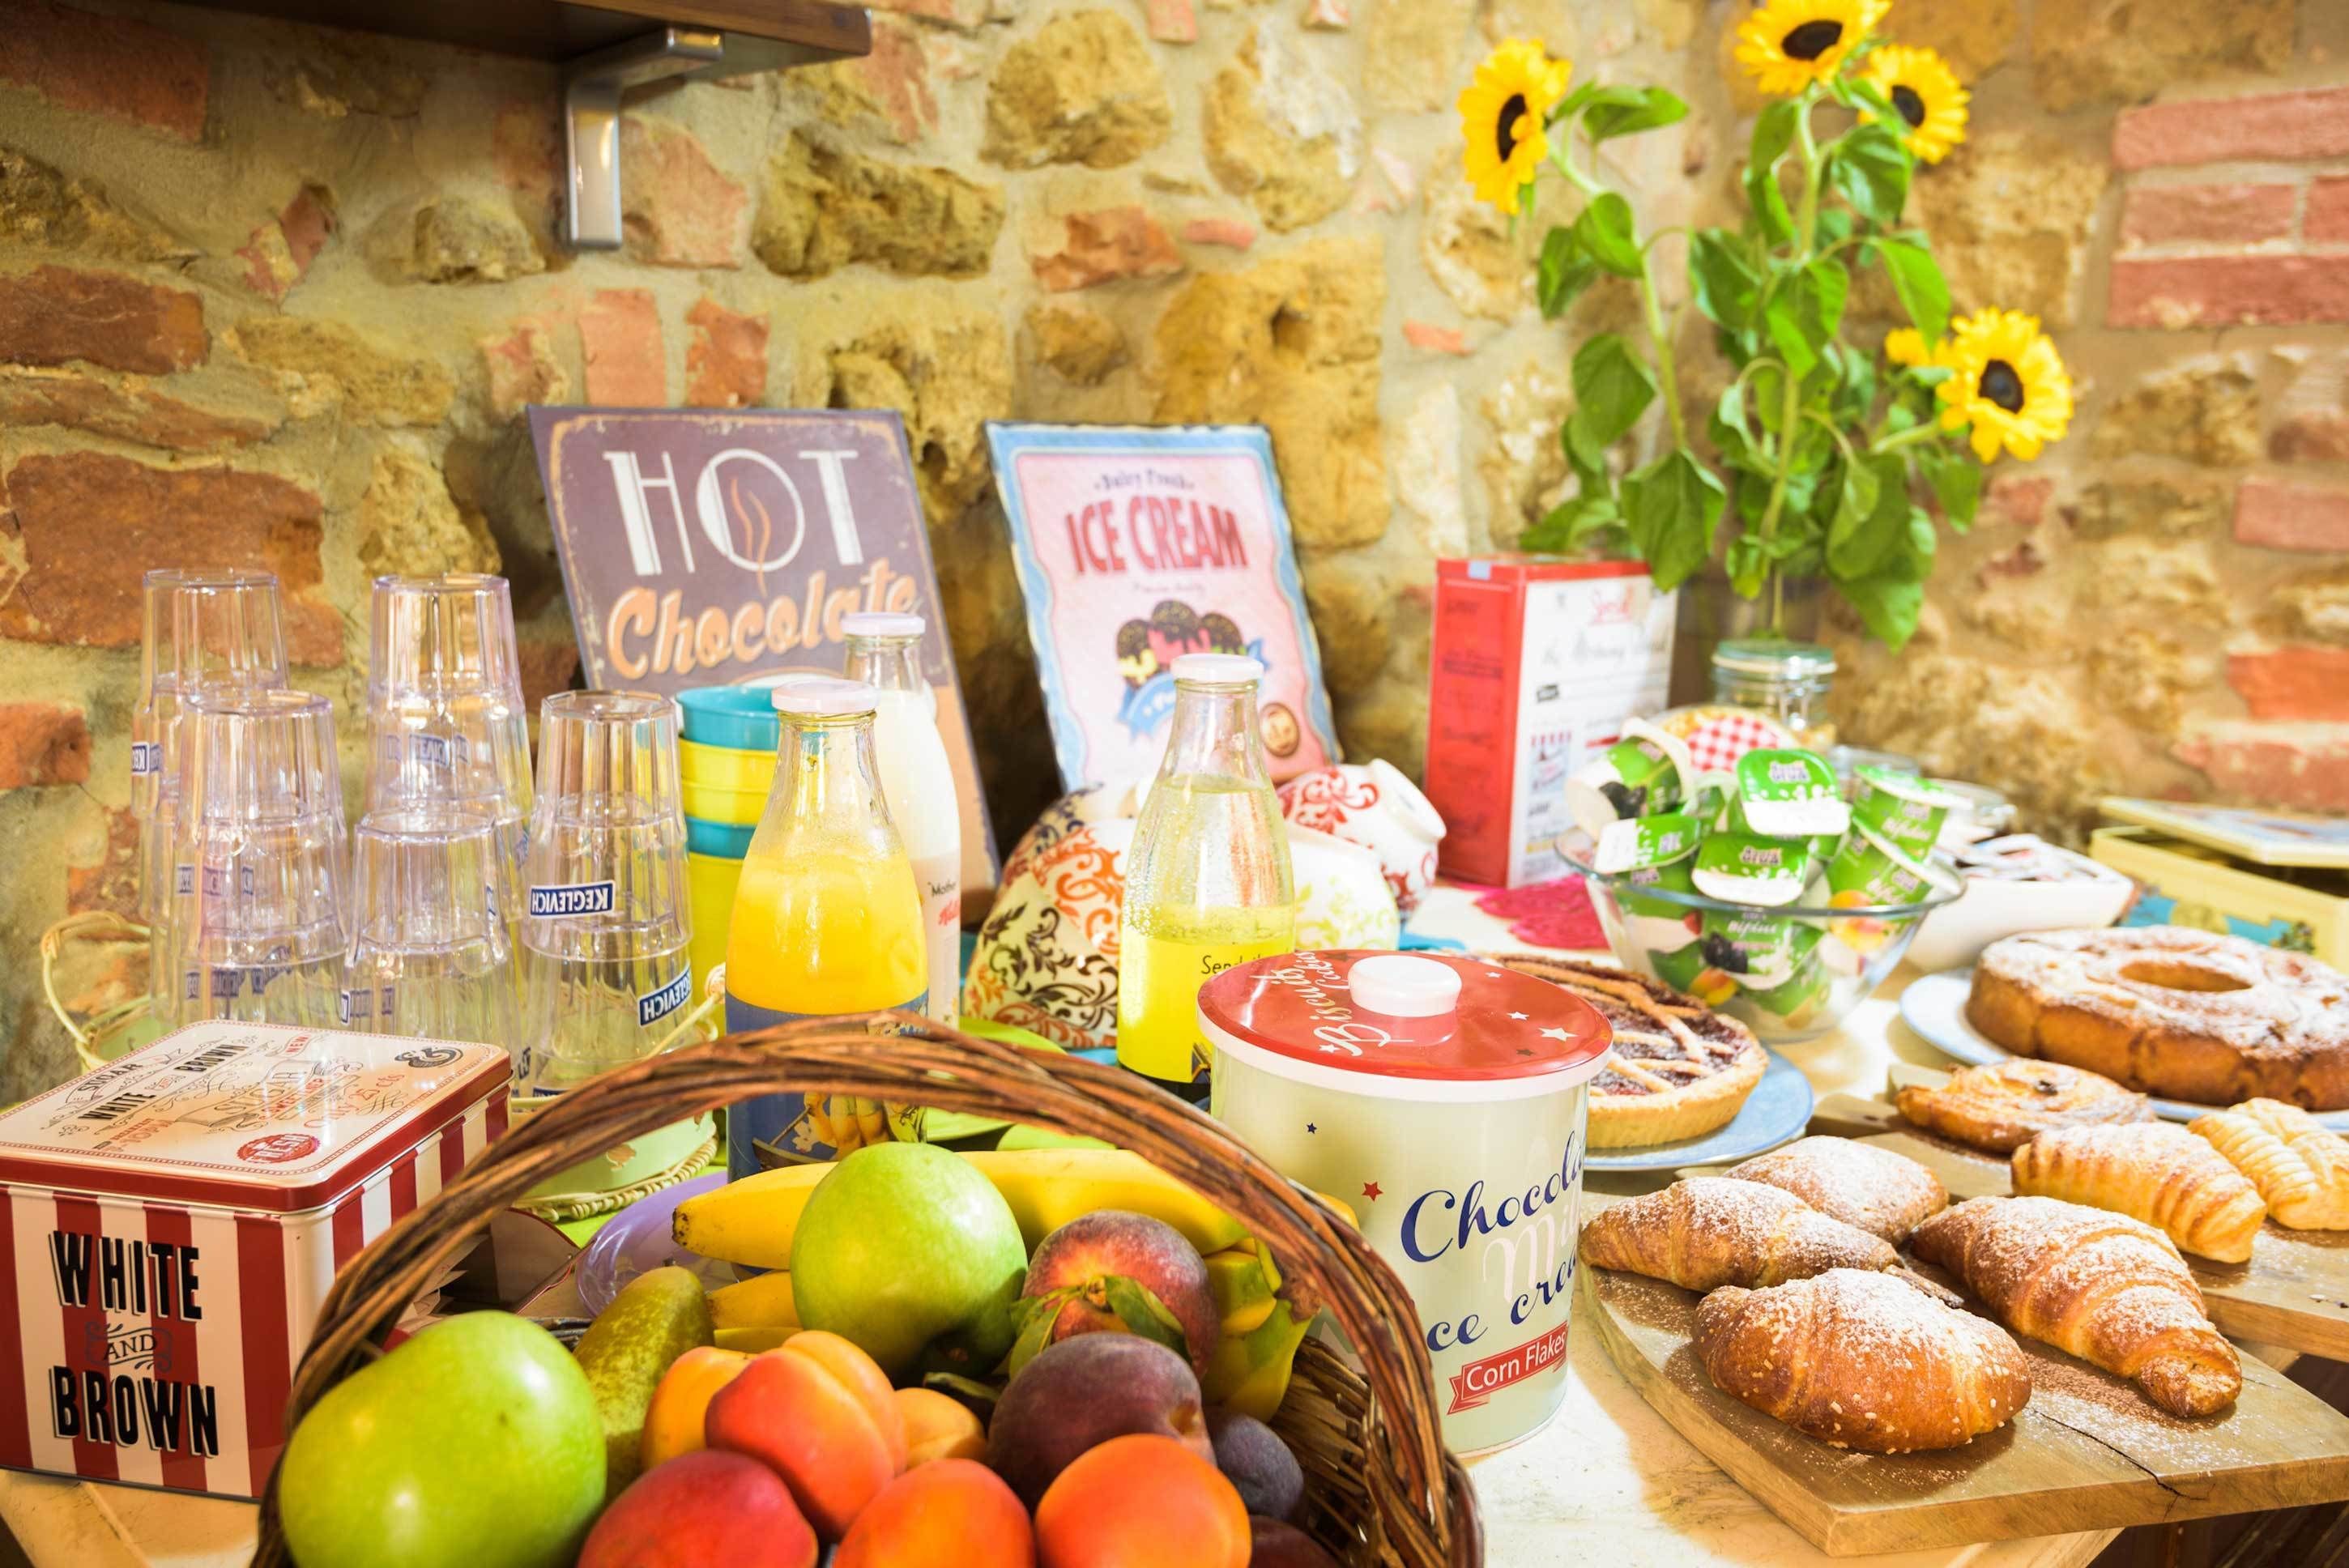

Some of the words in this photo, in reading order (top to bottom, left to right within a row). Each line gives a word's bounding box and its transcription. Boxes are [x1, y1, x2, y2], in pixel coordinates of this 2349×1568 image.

[603, 448, 863, 575] HOT
[1065, 500, 1127, 574] ICE
[1128, 495, 1248, 571] CREAM
[608, 558, 922, 680] Chocolate
[531, 887, 609, 914] KEGLEVICH
[1200, 955, 1243, 974] Sen
[642, 972, 692, 1022] GLEVICH
[1249, 967, 1414, 1057] Biscuits
[78, 1063, 143, 1093] SUGAR
[78, 1092, 156, 1121] WHITE
[173, 1043, 249, 1072] BROWN
[394, 1045, 464, 1069] &
[245, 1134, 311, 1164] FRESH
[1483, 1182, 1580, 1303] Mil
[49, 1230, 202, 1322] WHITE
[104, 1334, 157, 1360] AND
[1426, 1314, 1489, 1352] ce
[1465, 1357, 1520, 1391] Corn
[1525, 1331, 1567, 1371] Flakes
[49, 1366, 220, 1457] BROWN
